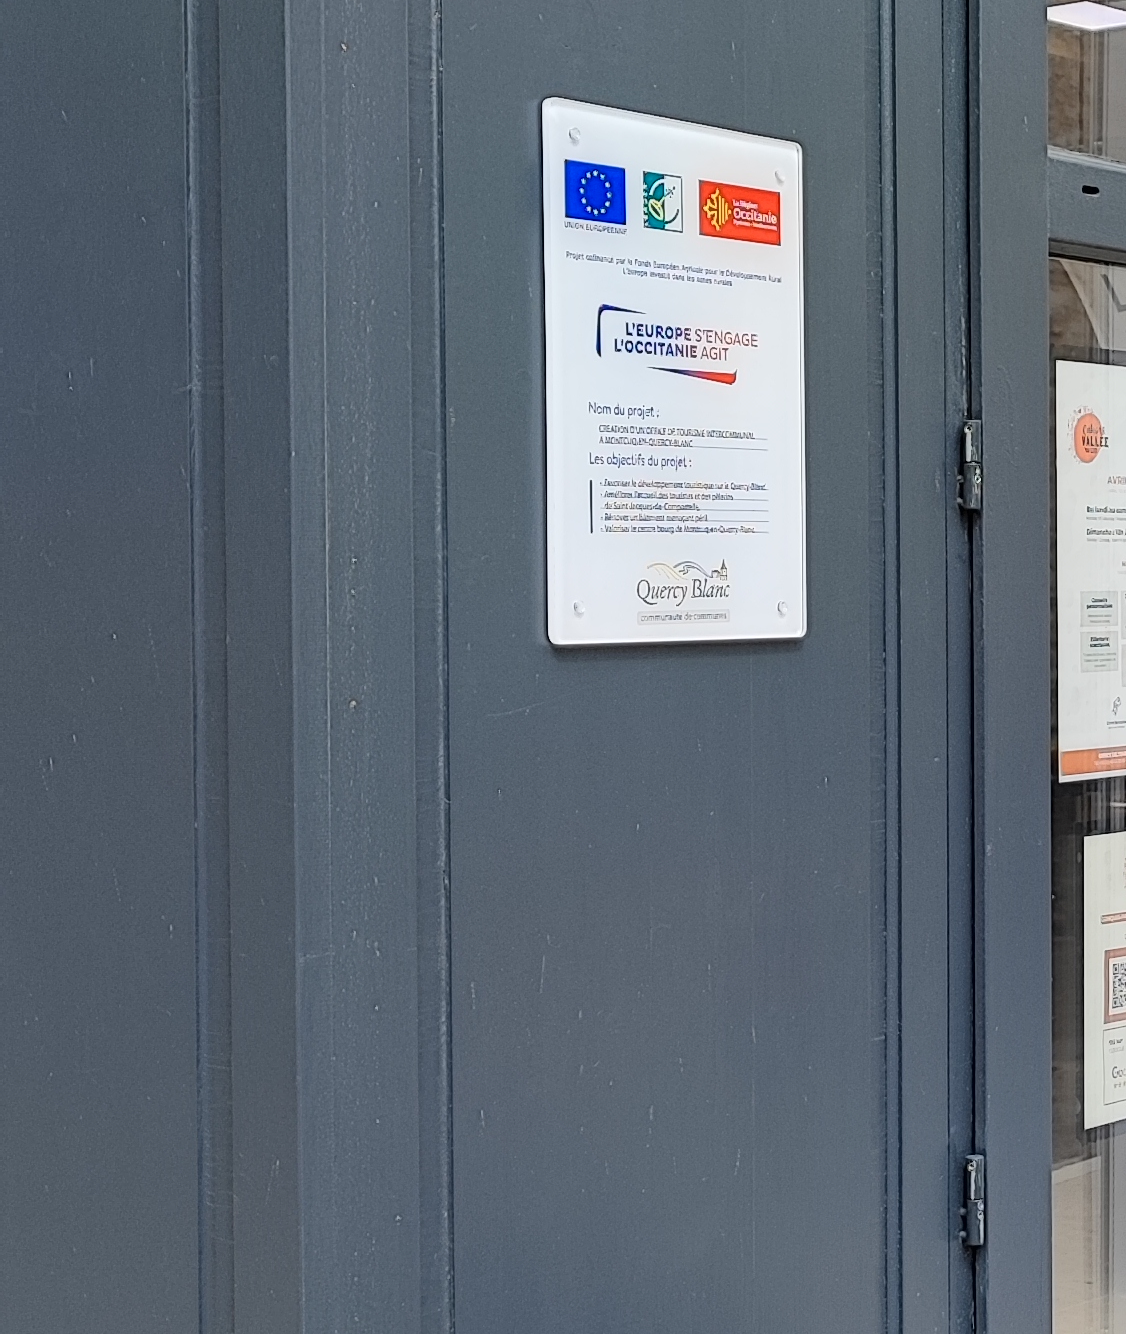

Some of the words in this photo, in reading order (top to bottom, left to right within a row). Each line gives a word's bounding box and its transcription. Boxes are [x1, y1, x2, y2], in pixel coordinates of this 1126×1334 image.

[733, 207, 777, 224] Occitanie
[625, 321, 692, 341] L'EUROPE
[695, 328, 758, 348] S'ENGAGE
[614, 338, 698, 358] L'OCCITANIE
[700, 346, 730, 361] AGIT
[588, 402, 612, 415] Nom
[613, 404, 625, 417] du
[627, 406, 655, 420] projet
[589, 452, 604, 465] Les
[606, 451, 645, 468] objectifs
[647, 454, 659, 467] du
[661, 455, 687, 471] projet
[636, 579, 688, 607] Quercy
[690, 578, 731, 598] Blanc
[683, 612, 692, 621] de
